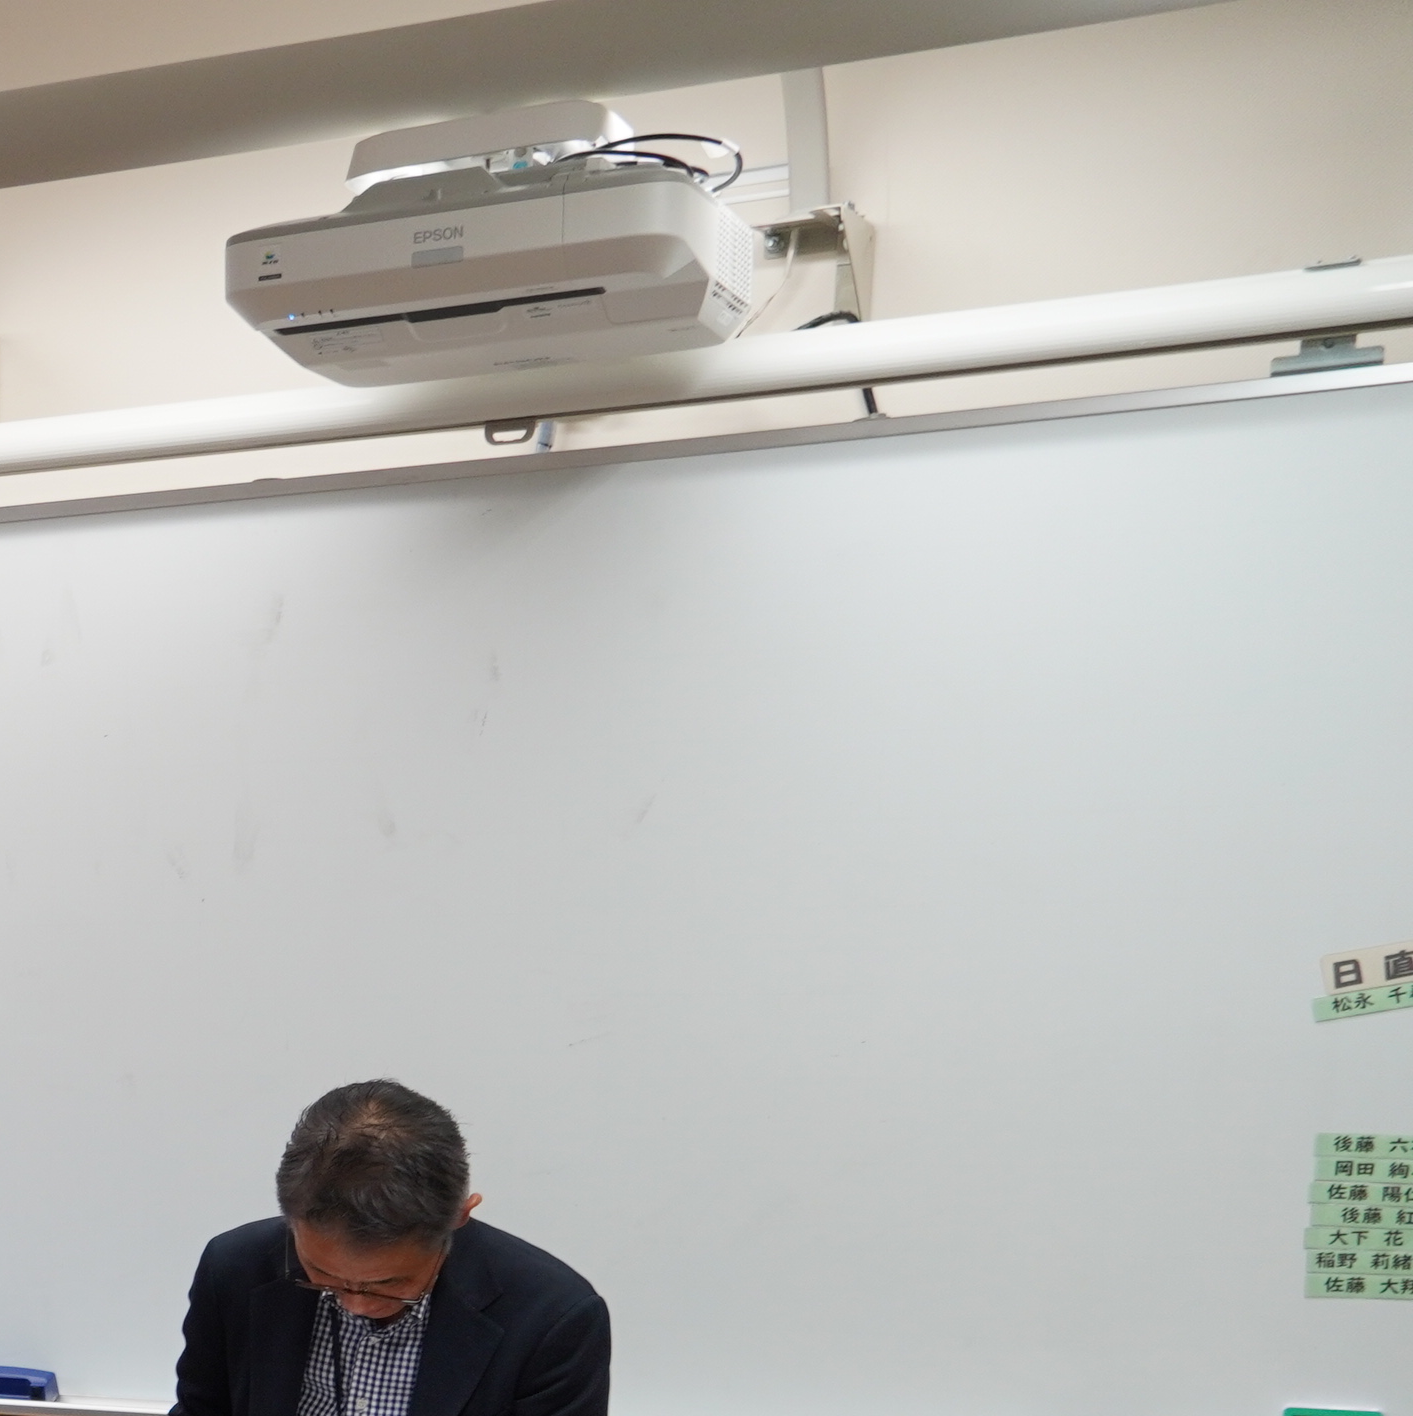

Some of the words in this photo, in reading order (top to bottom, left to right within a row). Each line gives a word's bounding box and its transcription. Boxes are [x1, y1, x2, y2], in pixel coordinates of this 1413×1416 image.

[413, 225, 464, 244] EPSON
[1332, 992, 1374, 1013] 松永
[1334, 1135, 1375, 1153] 後藤
[1335, 1160, 1374, 1177] 岡田
[1327, 1184, 1369, 1201] 佐藤
[1341, 1207, 1382, 1224] 後藤
[1329, 1229, 1369, 1246] 大下
[1384, 1230, 1404, 1246] 花
[1316, 1252, 1357, 1269] 稲野
[1324, 1276, 1366, 1294] 佐藤
